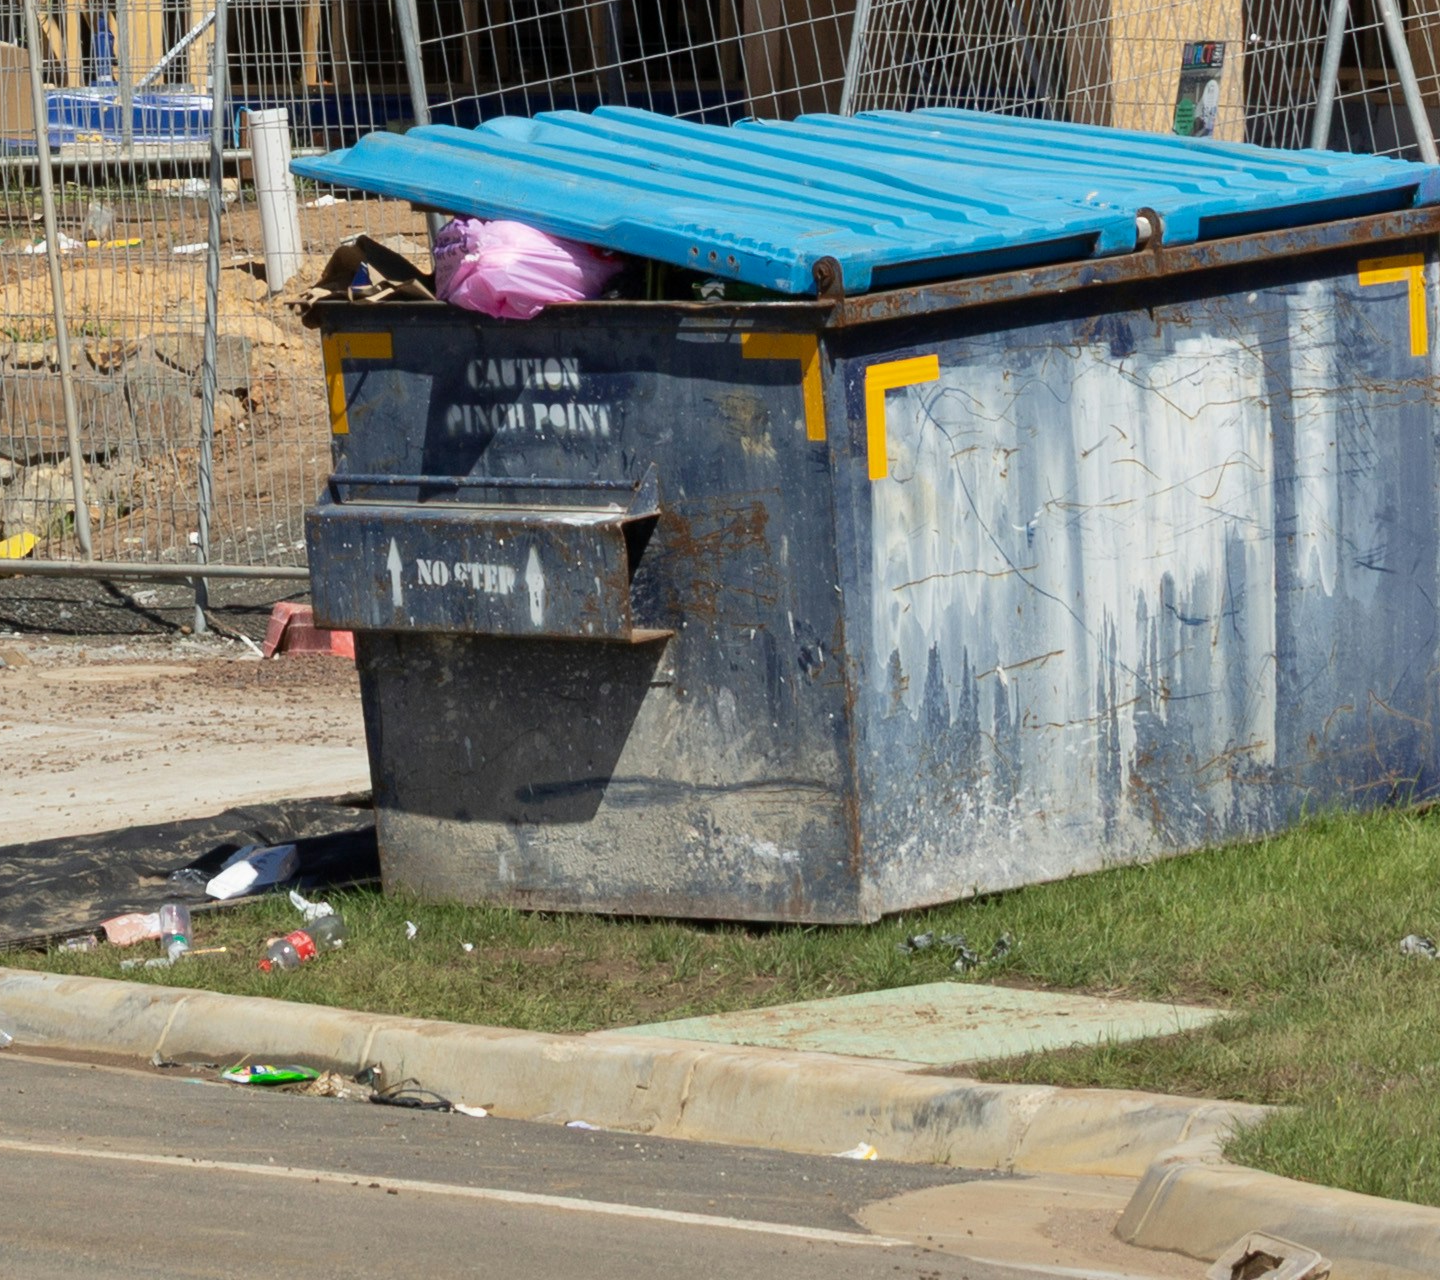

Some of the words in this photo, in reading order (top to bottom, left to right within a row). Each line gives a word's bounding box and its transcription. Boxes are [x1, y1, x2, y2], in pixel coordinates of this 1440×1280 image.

[467, 357, 580, 390] CAUTION
[446, 403, 526, 436] PINCH
[532, 403, 611, 437] POINT
[417, 558, 450, 587] NO
[454, 561, 515, 595] STEP
